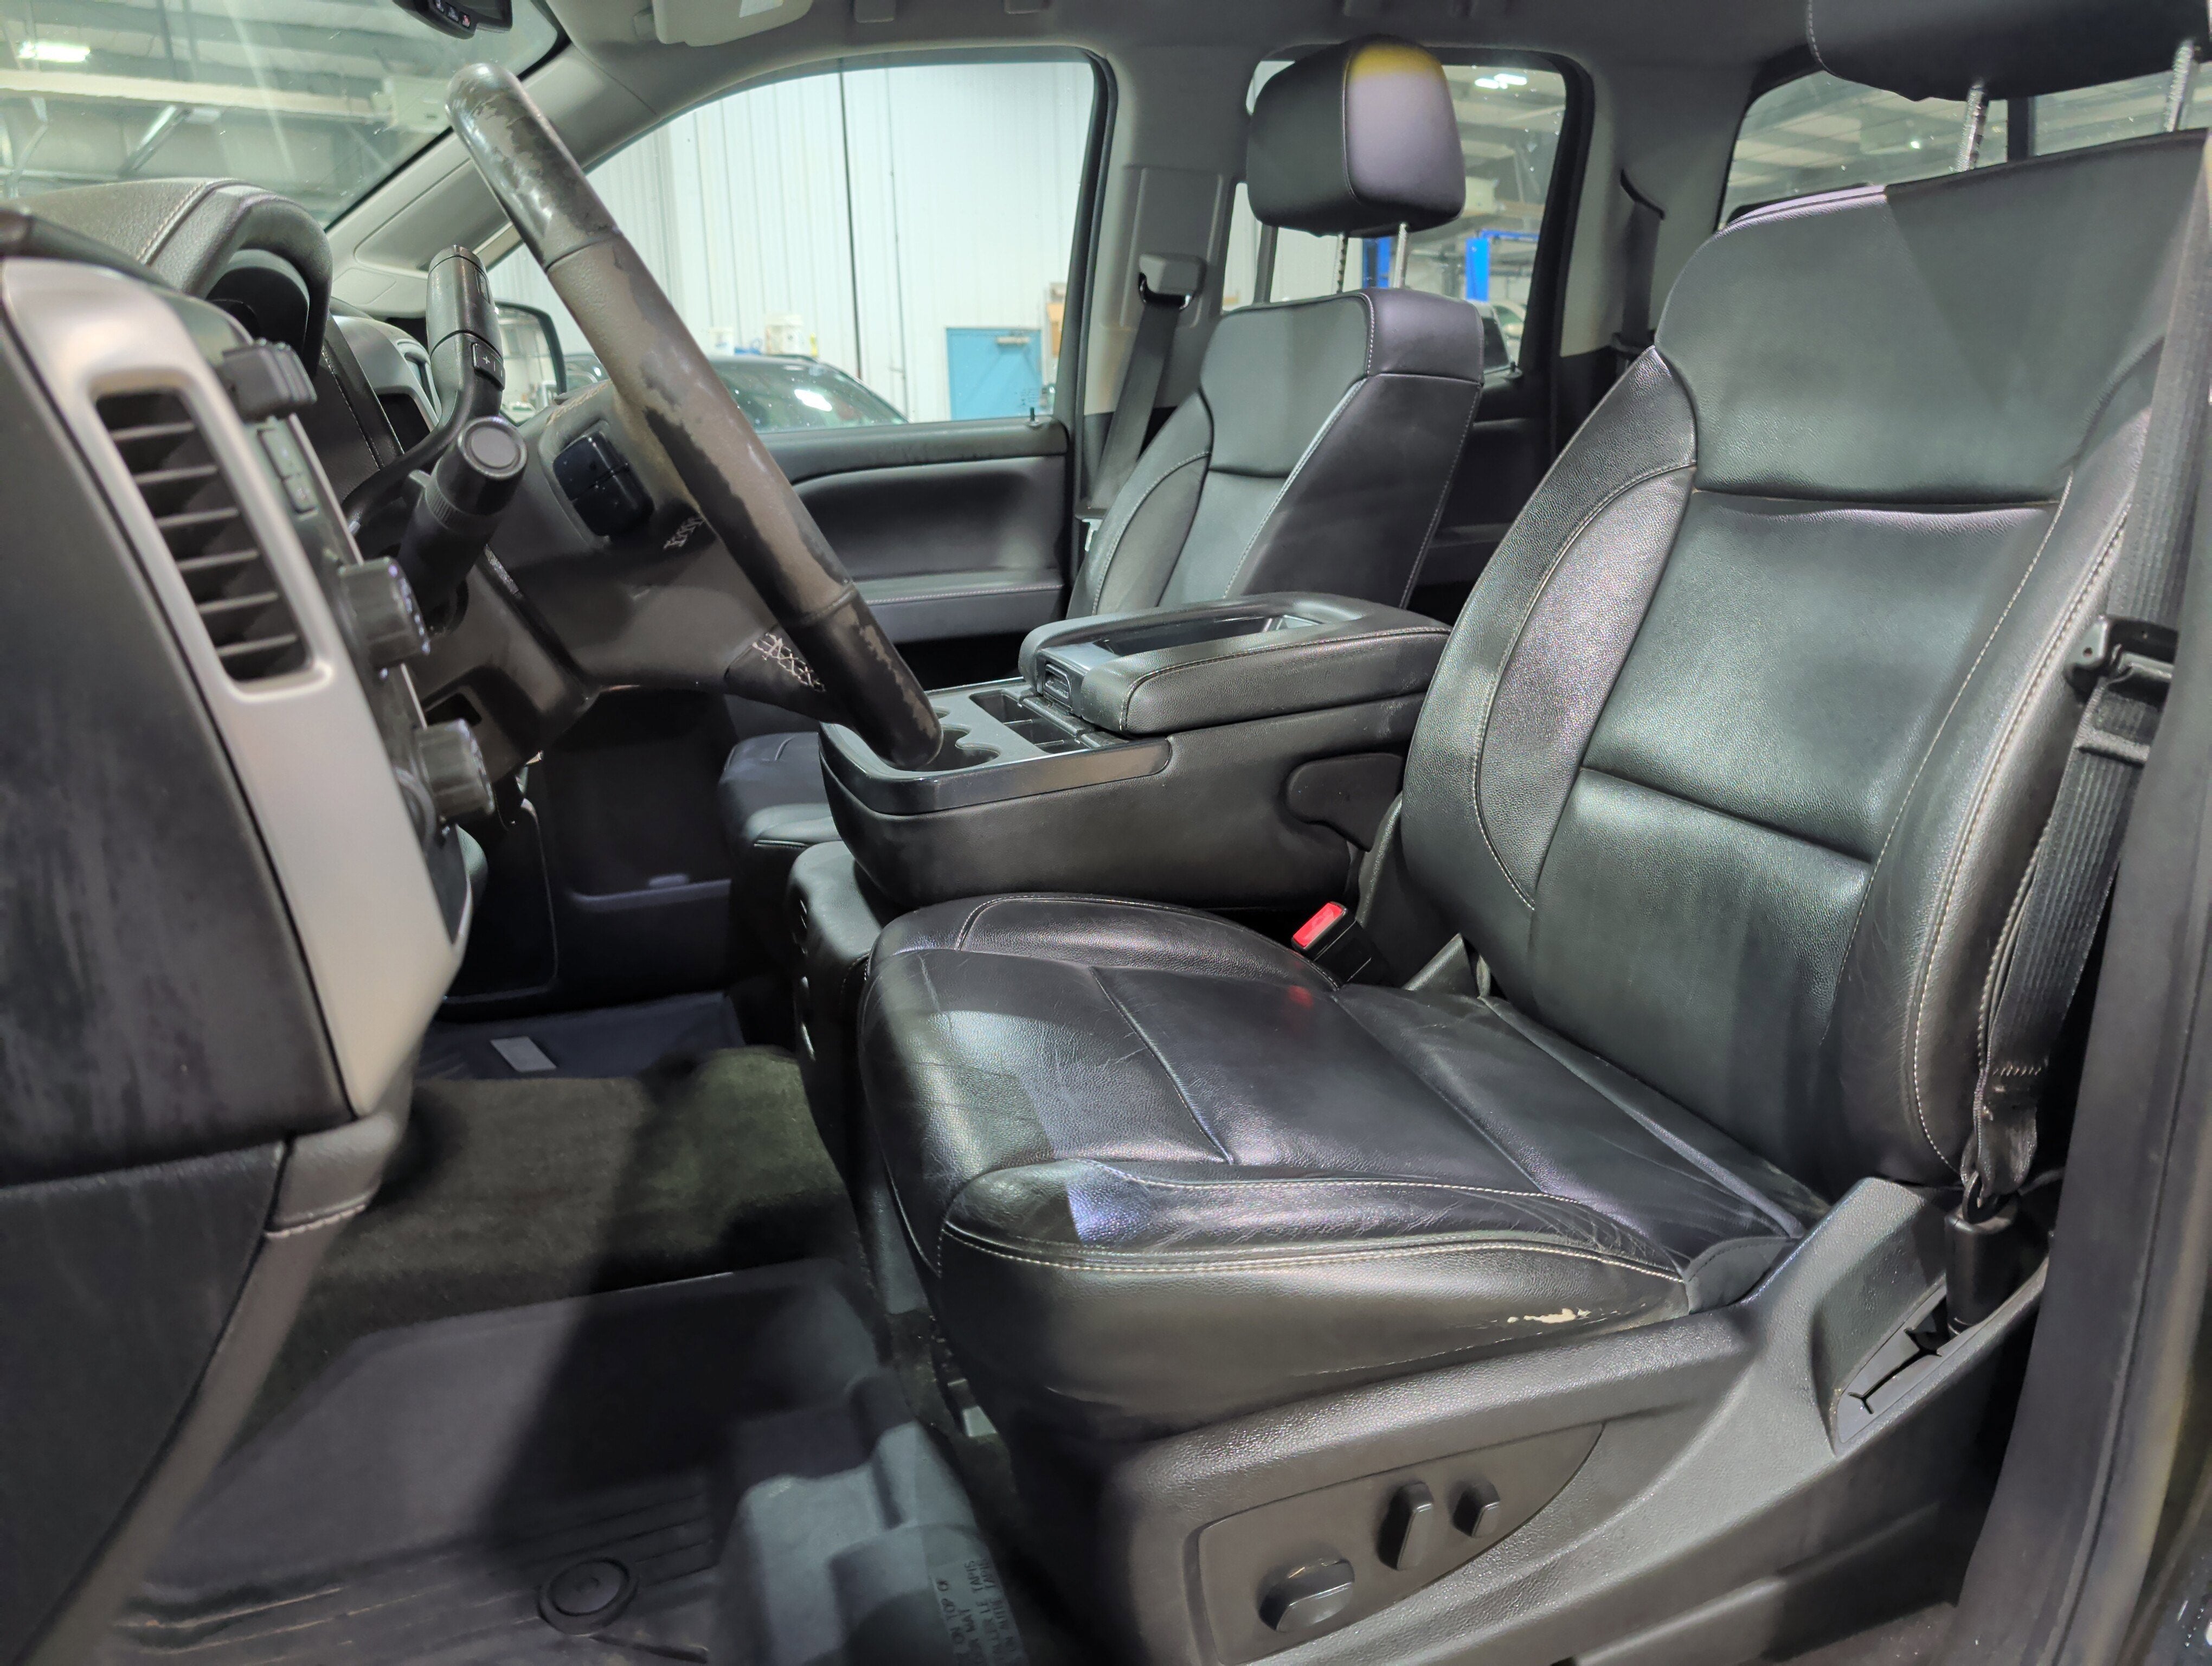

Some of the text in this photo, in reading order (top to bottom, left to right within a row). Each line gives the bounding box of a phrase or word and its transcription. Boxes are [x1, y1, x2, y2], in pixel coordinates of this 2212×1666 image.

[964, 1560, 984, 1593] TAPIS
[941, 1598, 955, 1620] TOP
[956, 1609, 976, 1633] MAT
